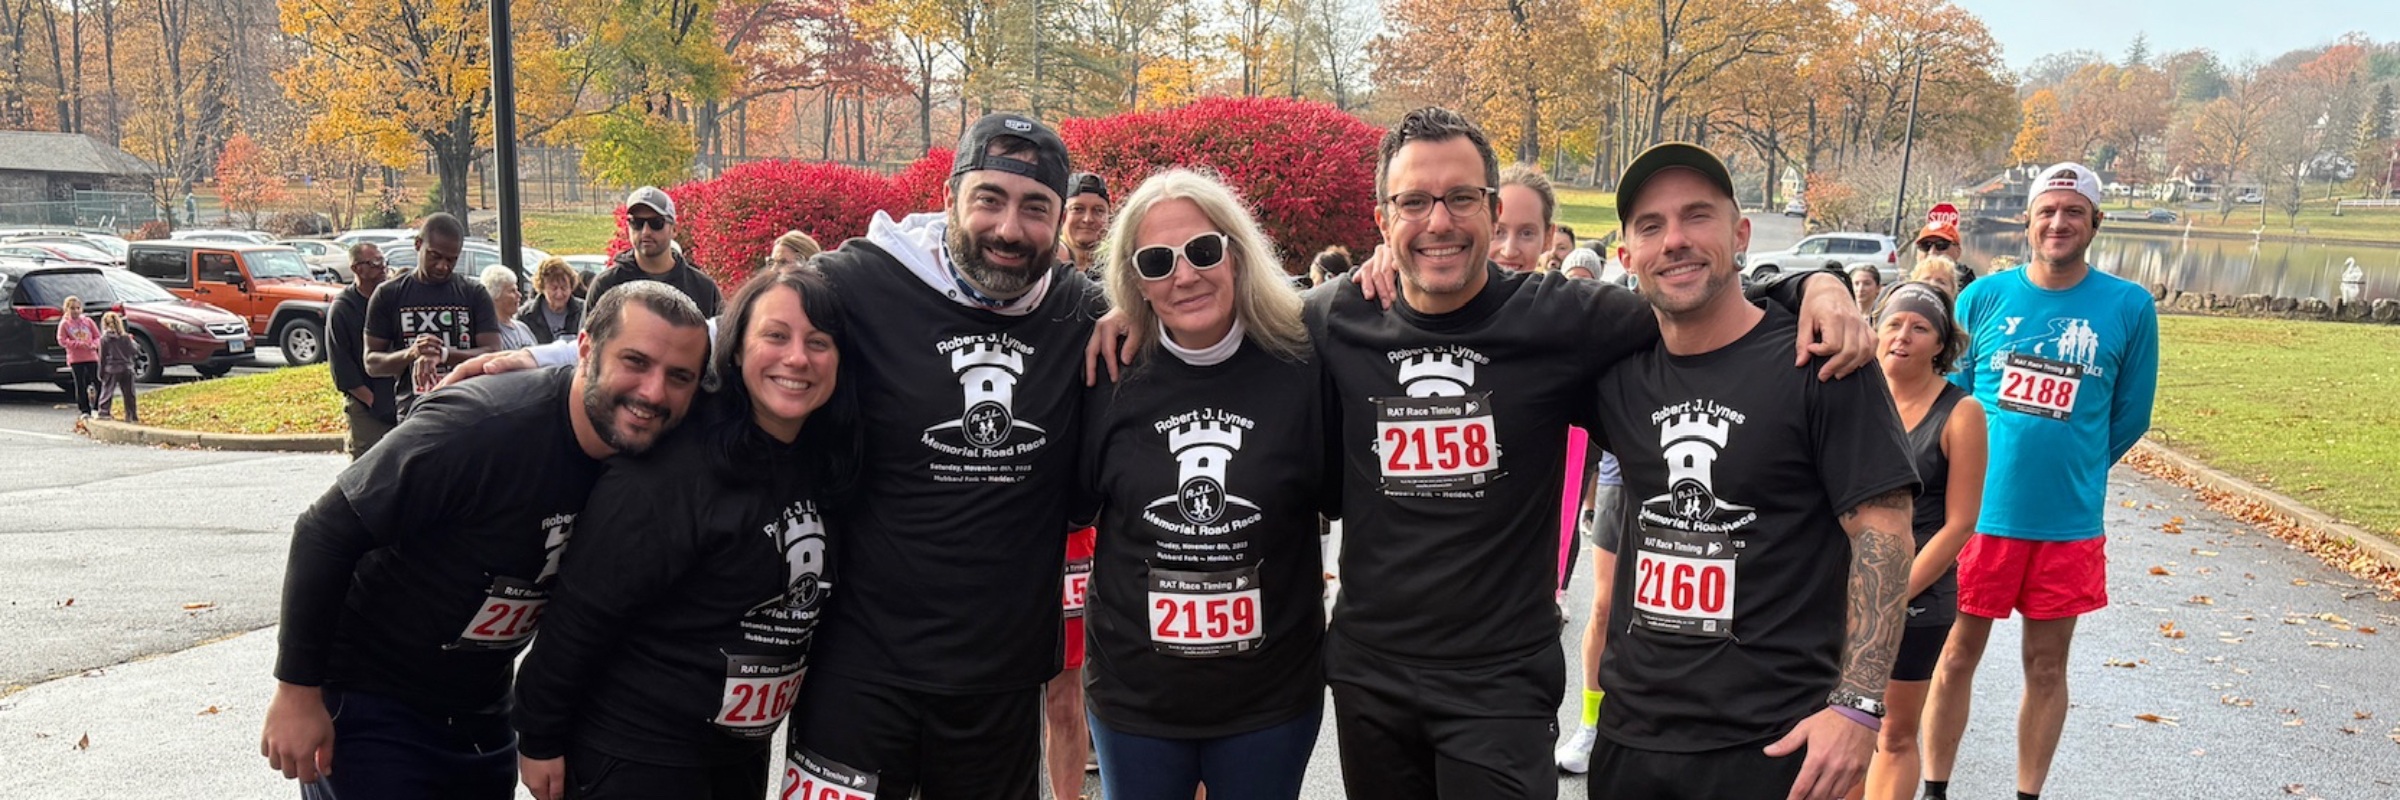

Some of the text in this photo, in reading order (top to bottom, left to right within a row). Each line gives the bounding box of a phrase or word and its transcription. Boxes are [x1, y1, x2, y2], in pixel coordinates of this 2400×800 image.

[1930, 211, 1957, 226] STOP
[936, 333, 1035, 355] Robert J. Lynes
[1451, 344, 1491, 365] Lynes
[2003, 371, 2073, 408] 2188
[1154, 408, 1255, 434] Robert J. Lynes
[1387, 406, 1461, 417] RAT Race Timing
[1651, 399, 1746, 425] Robert J. Lynes
[921, 432, 1046, 458] Memorial Road Race
[1384, 423, 1489, 471] 2158
[794, 501, 805, 514] J.
[1638, 506, 1690, 530] Memorial
[542, 513, 577, 530] Robe
[1142, 510, 1262, 536] Memorial Road Race
[1644, 536, 1703, 555] RAT Race Timing
[1184, 554, 1199, 562] Park
[1159, 580, 1233, 590] RAT Race Timing
[1637, 558, 1726, 613] 2160
[1155, 597, 1255, 638] 2159
[740, 665, 758, 674] RAT
[759, 666, 779, 674] Race
[724, 674, 803, 722] 2162
[805, 758, 821, 773] Race
[822, 767, 850, 784] Timing
